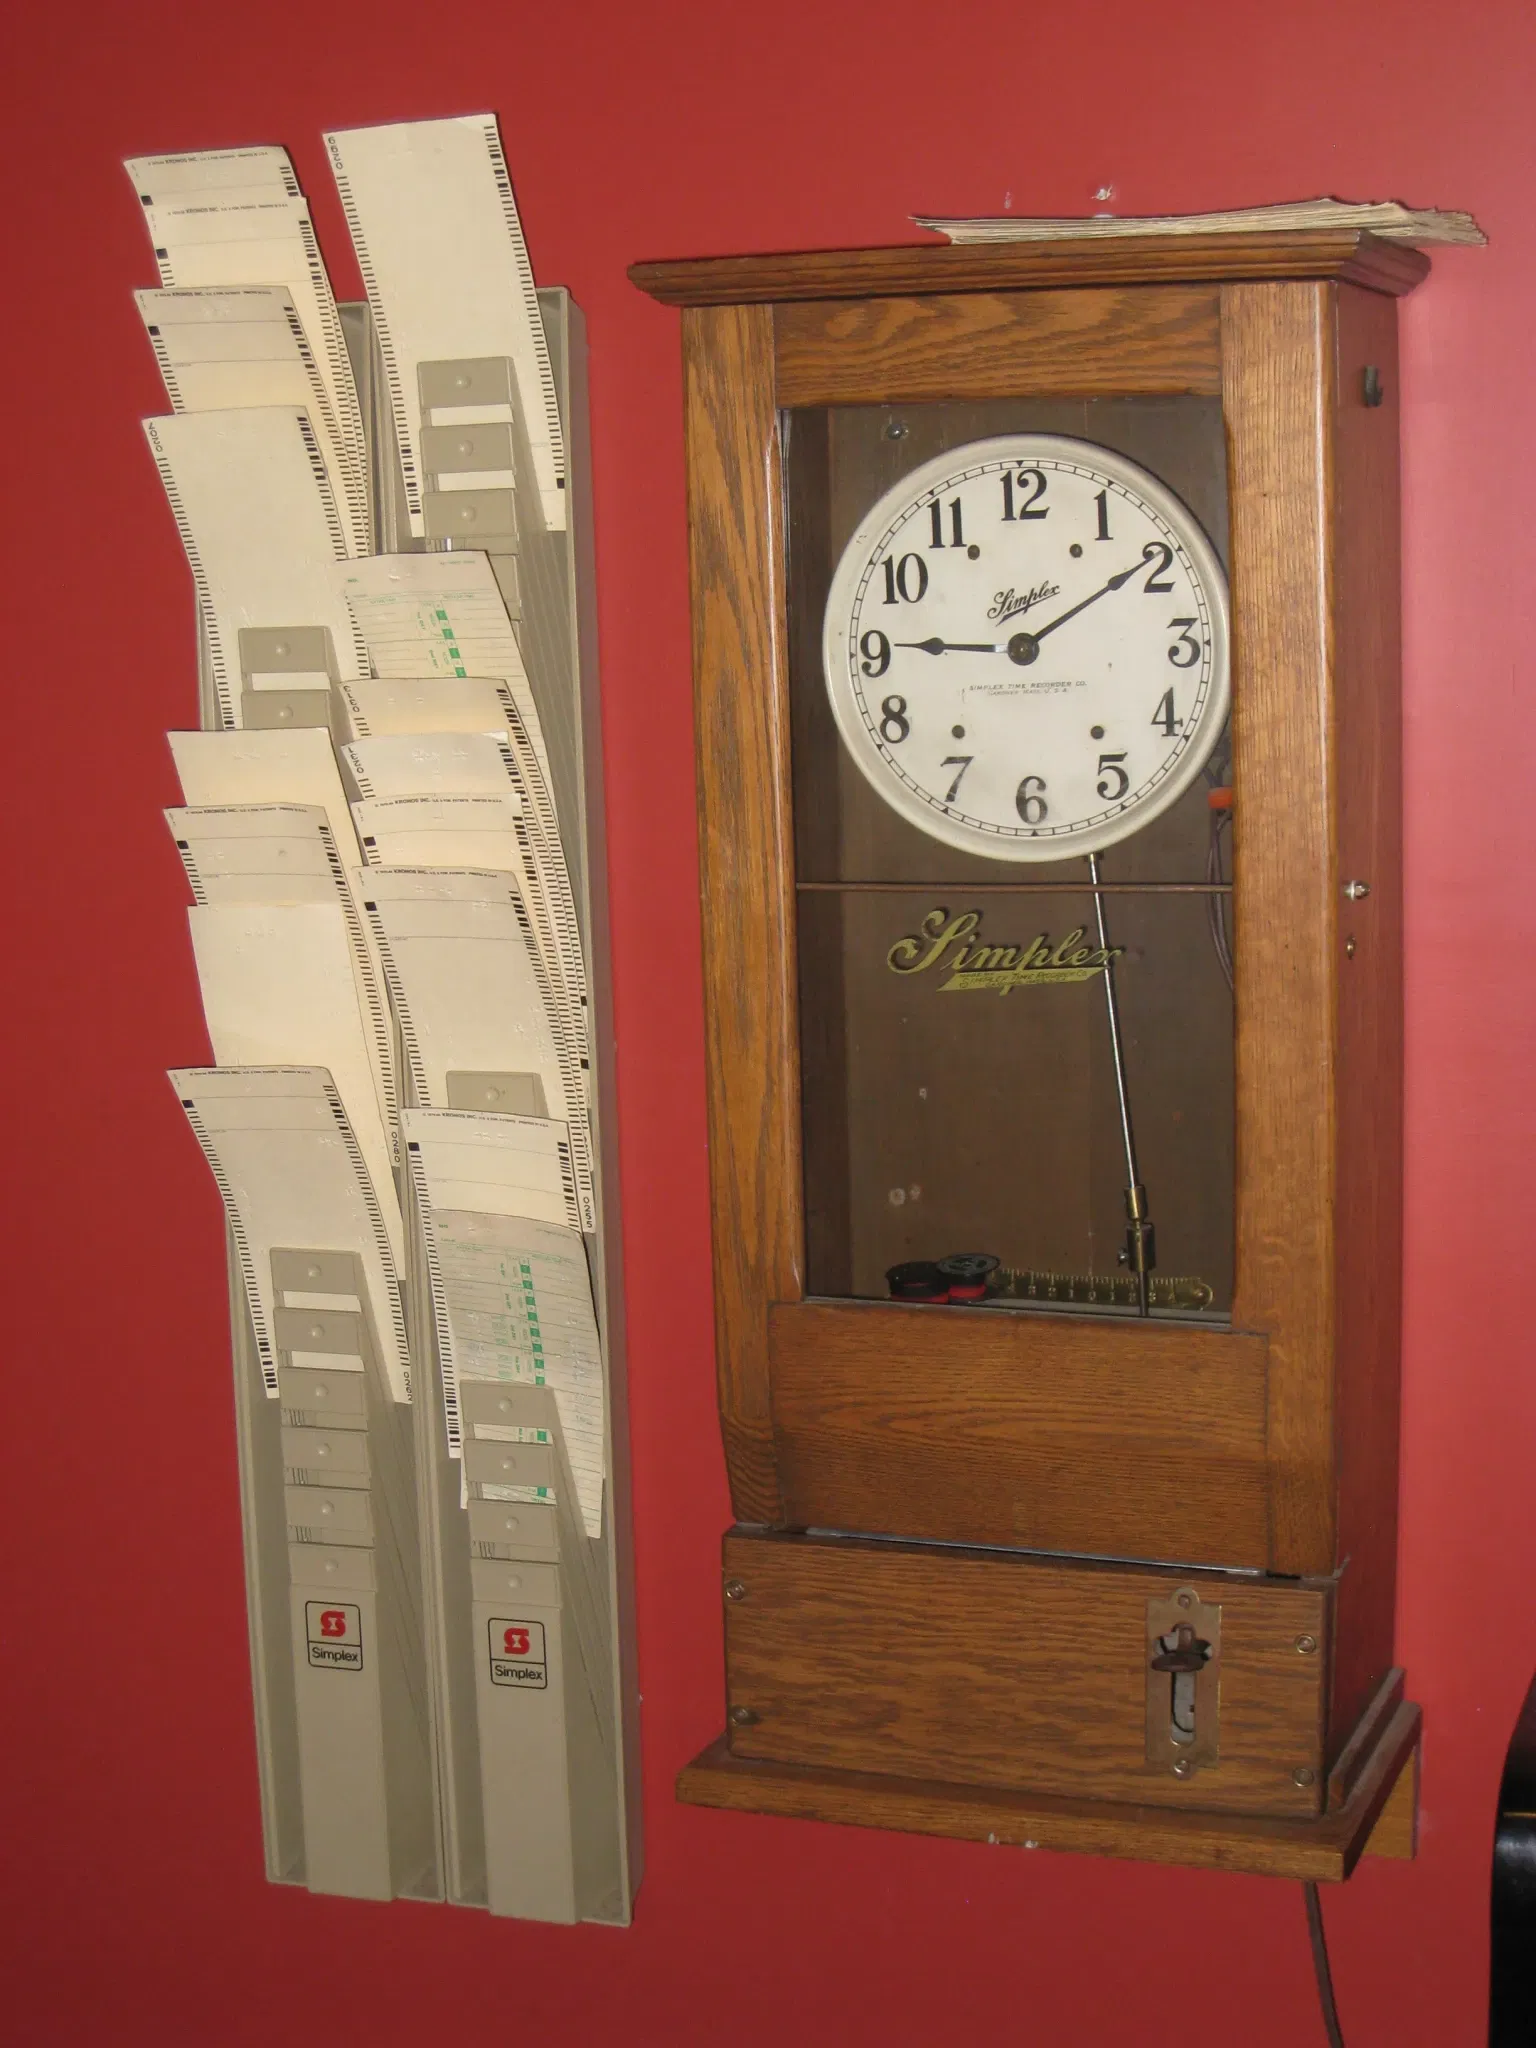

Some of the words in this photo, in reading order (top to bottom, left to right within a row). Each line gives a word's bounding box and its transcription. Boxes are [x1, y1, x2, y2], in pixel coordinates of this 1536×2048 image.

[1000, 469, 1050, 521] 12
[1094, 489, 1114, 541] 1
[927, 497, 967, 548] 11
[881, 552, 928, 605] 10
[1142, 541, 1176, 593] 2
[987, 580, 1060, 620] Simplex
[860, 629, 891, 678] 9
[1167, 617, 1201, 668] 3
[880, 695, 910, 744] 8
[1151, 687, 1184, 737] 4
[940, 755, 974, 803] 7
[1015, 775, 1048, 825] 6
[1096, 752, 1130, 800] 5
[887, 910, 1122, 996] Simplex
[312, 1647, 358, 1662] Simplex
[495, 1665, 543, 1680] Simplex
